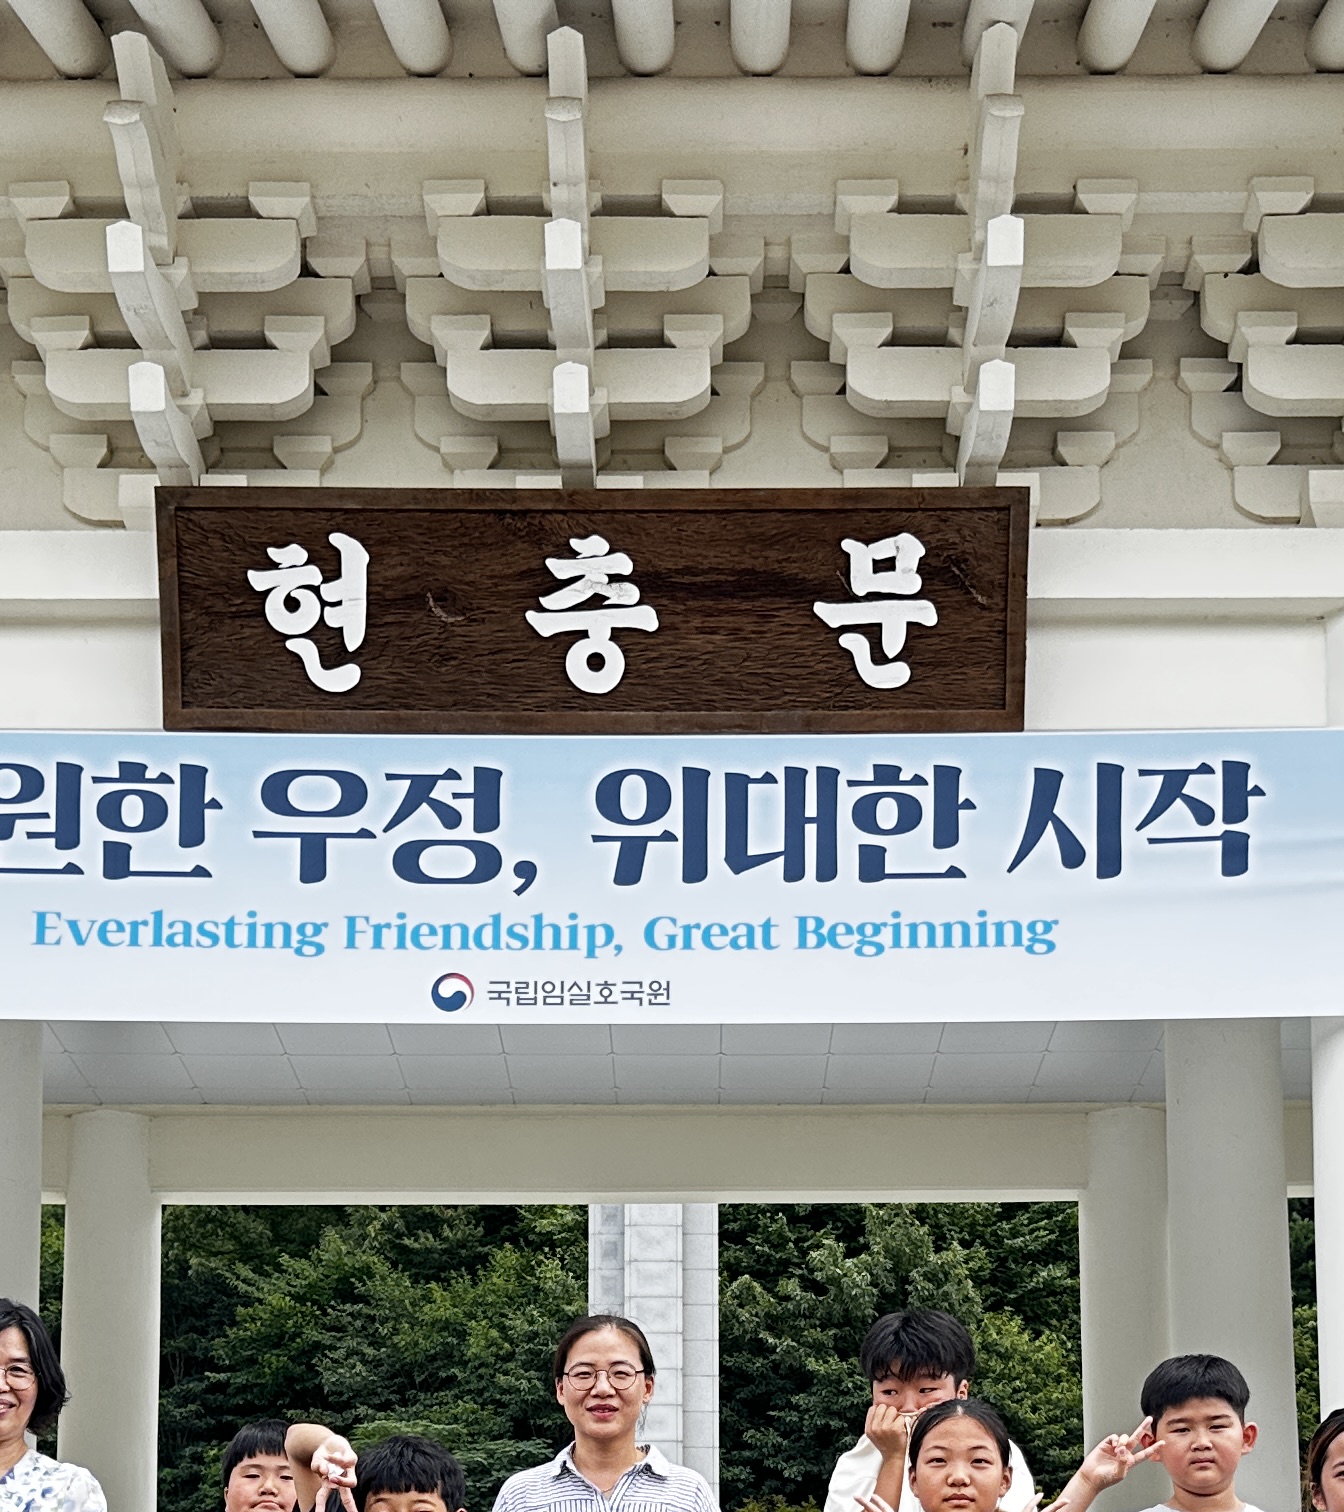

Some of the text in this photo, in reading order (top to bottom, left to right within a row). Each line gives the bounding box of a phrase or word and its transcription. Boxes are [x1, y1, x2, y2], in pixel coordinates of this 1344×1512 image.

[248, 532, 938, 694] 현충문
[251, 765, 538, 897] 우정,
[590, 762, 978, 887] 위대한
[1006, 759, 1267, 880] 시작
[31, 909, 1060, 959] Everlasting Friendship, Great Beginning
[486, 979, 671, 1007] 국립임실호국원
